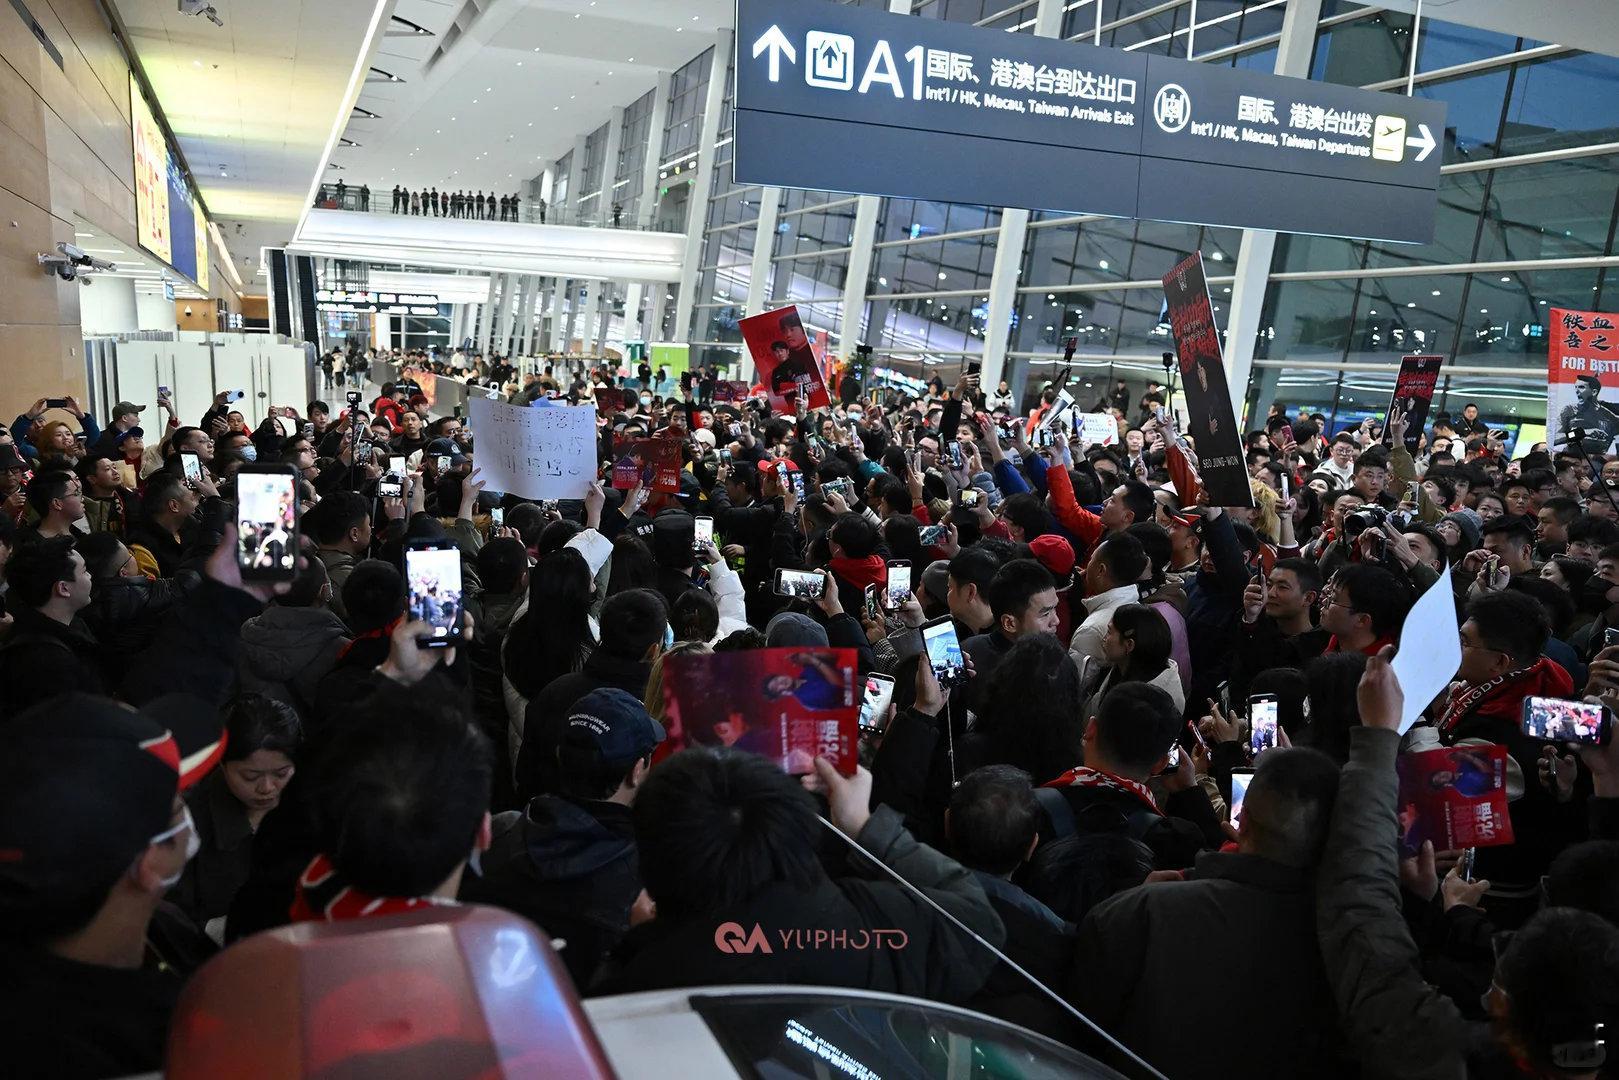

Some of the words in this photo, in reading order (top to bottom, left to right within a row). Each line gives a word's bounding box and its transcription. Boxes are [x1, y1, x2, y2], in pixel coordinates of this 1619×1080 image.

[858, 39, 924, 100] A1
[926, 49, 1137, 105] 国际、港澳台到达出口
[925, 85, 951, 101] Int'l
[951, 88, 959, 103] /
[959, 90, 981, 108] HK,
[984, 93, 1026, 114] Macau,
[1028, 99, 1070, 118] Taiwan
[1071, 106, 1112, 124] Arrivals
[1113, 110, 1135, 126] Exit
[1238, 95, 1373, 138] 国际、港澳台出发
[1190, 120, 1213, 137] Int'l
[1220, 124, 1240, 142] HK,
[1242, 127, 1279, 147] Macau,
[1280, 132, 1317, 150] Taiwan
[1318, 138, 1371, 157] Departures
[1562, 312, 1616, 332] 铁血
[1561, 356, 1586, 371] FOR
[1589, 358, 1619, 374] BETT
